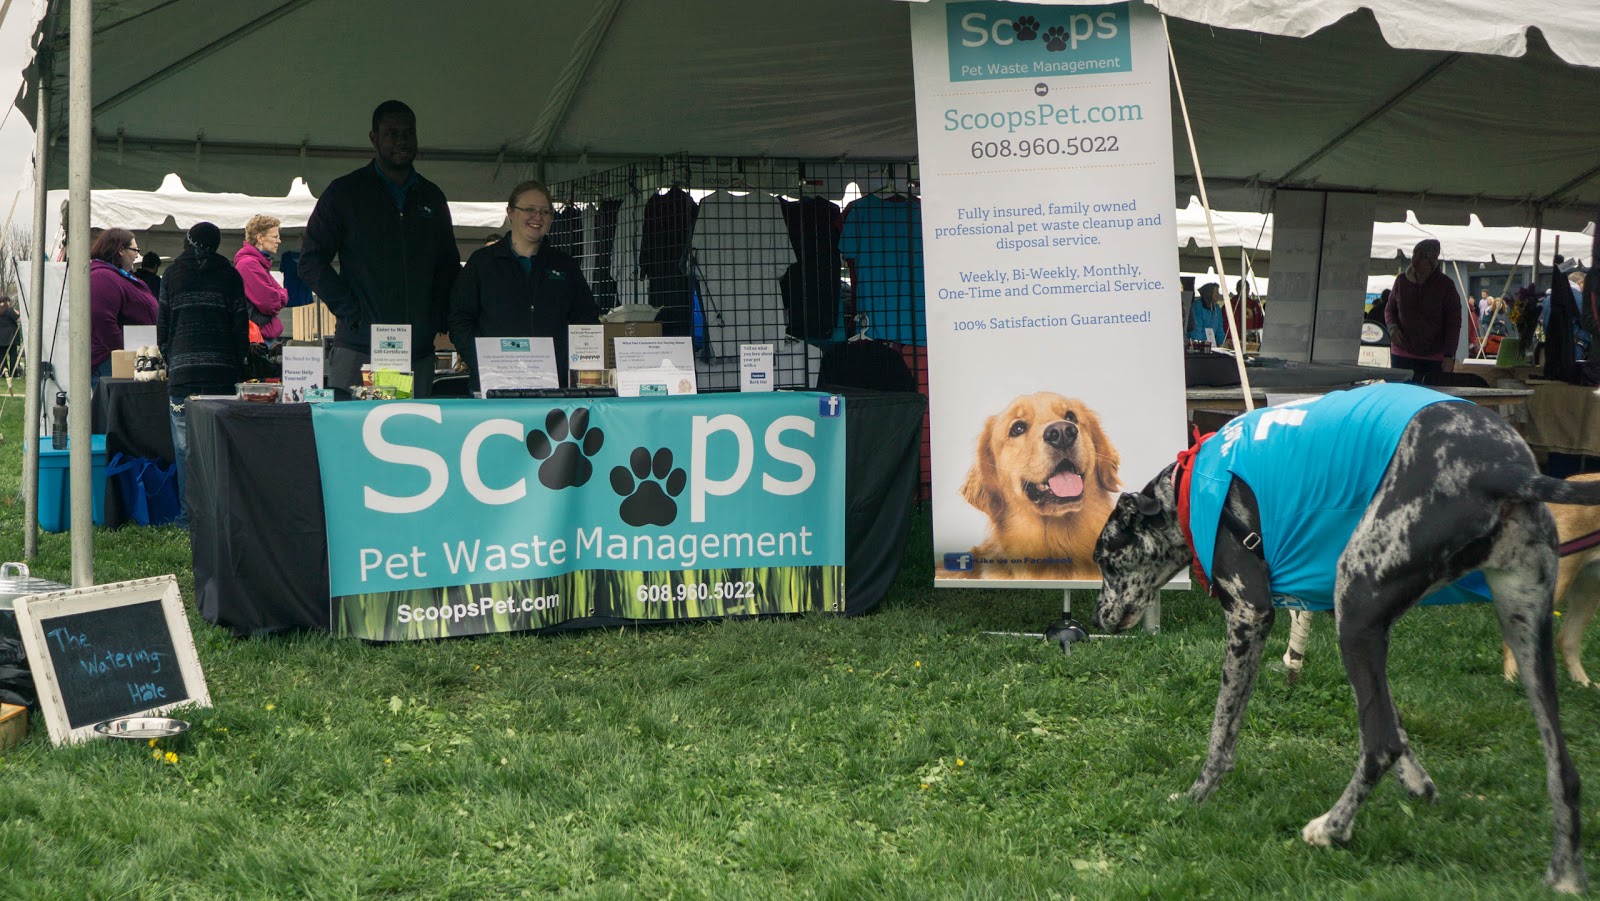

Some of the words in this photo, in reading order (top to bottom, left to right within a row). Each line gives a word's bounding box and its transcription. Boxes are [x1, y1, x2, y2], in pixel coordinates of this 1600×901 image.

[961, 65, 982, 76] Pet
[987, 63, 1028, 75] Waste
[1033, 57, 1120, 73] Management
[944, 103, 1144, 133] ScoopsPet.com
[971, 136, 1119, 159] 608.960.5022
[958, 207, 990, 221] Fully
[993, 204, 1045, 218] insured,
[1048, 202, 1090, 216] family
[1093, 199, 1136, 213] owned
[935, 222, 1014, 239] professional
[1018, 222, 1038, 236] pet
[1042, 220, 1079, 231] waste
[1083, 216, 1134, 231] cleanup
[1137, 214, 1162, 226] and
[996, 236, 1049, 251] disposal
[1052, 234, 1101, 247] service.
[960, 270, 1010, 284] Weekly,
[1012, 266, 1080, 281] Bi-Weekly,
[1083, 263, 1142, 278] Monthly,
[938, 286, 1002, 300] One-Time
[1004, 284, 1028, 297] and
[1032, 280, 1110, 296] Commercial
[1114, 278, 1165, 292] Service.
[954, 319, 986, 331] 100%
[990, 315, 1068, 330] Satisfaction
[1071, 310, 1152, 326] Guaranteed!
[360, 546, 427, 582] Pet
[442, 535, 566, 575] Waste
[576, 526, 813, 568] Management
[636, 581, 755, 602] 608.960.5022
[397, 592, 560, 623] ScoopsPet.com
[47, 626, 92, 653] The
[80, 648, 170, 675] Watering
